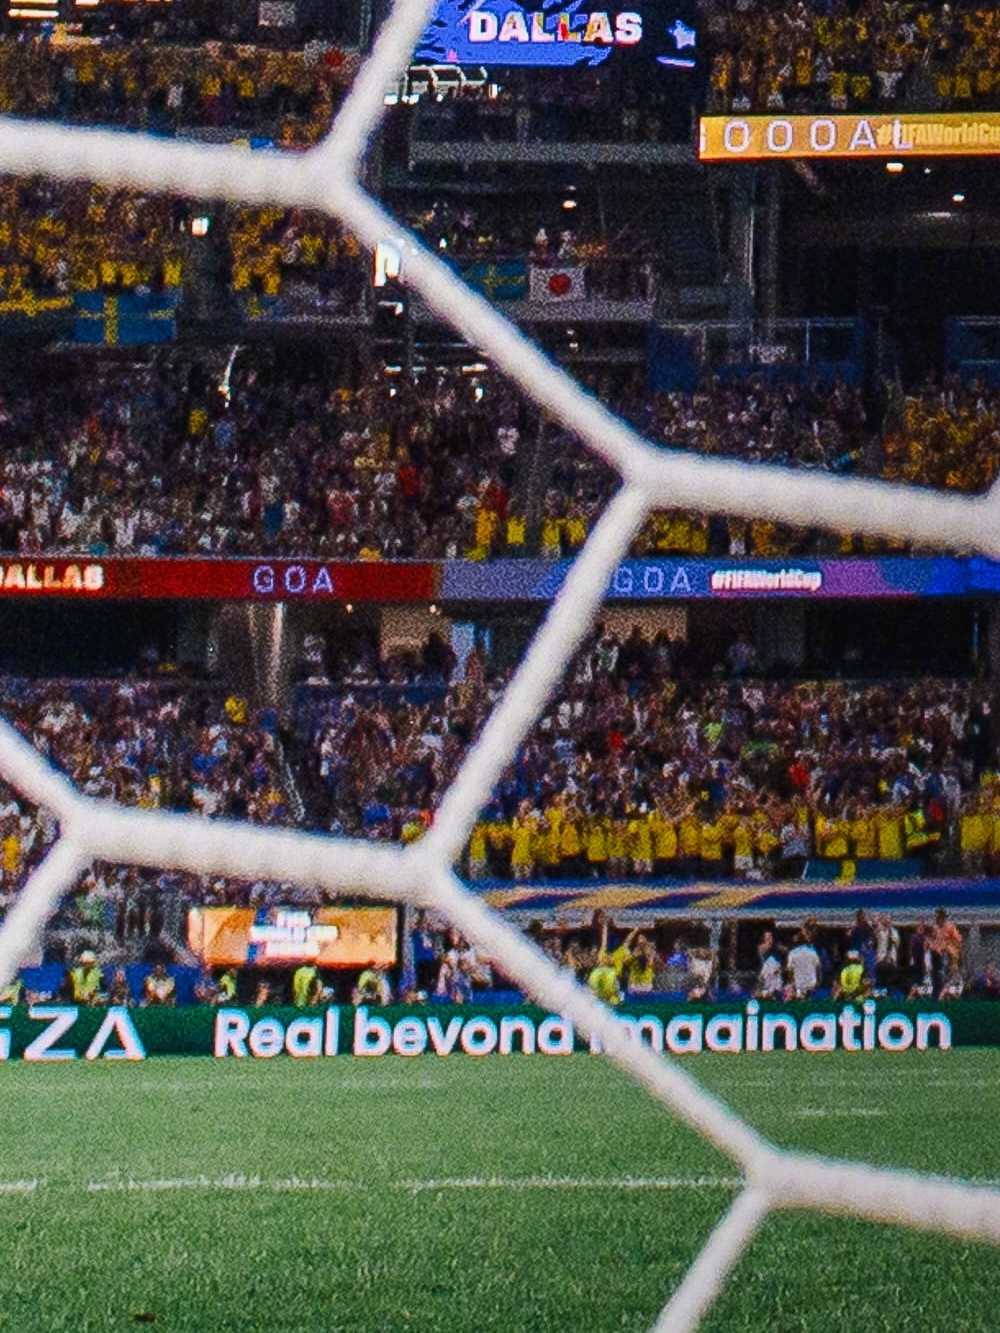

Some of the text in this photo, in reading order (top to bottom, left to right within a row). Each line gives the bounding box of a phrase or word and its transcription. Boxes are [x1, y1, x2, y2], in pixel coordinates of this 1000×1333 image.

[468, 10, 642, 44] DALLAS
[699, 118, 914, 154] OOOAL
[253, 565, 334, 594] GOA
[612, 567, 692, 593] GOA
[214, 1005, 340, 1058] Real
